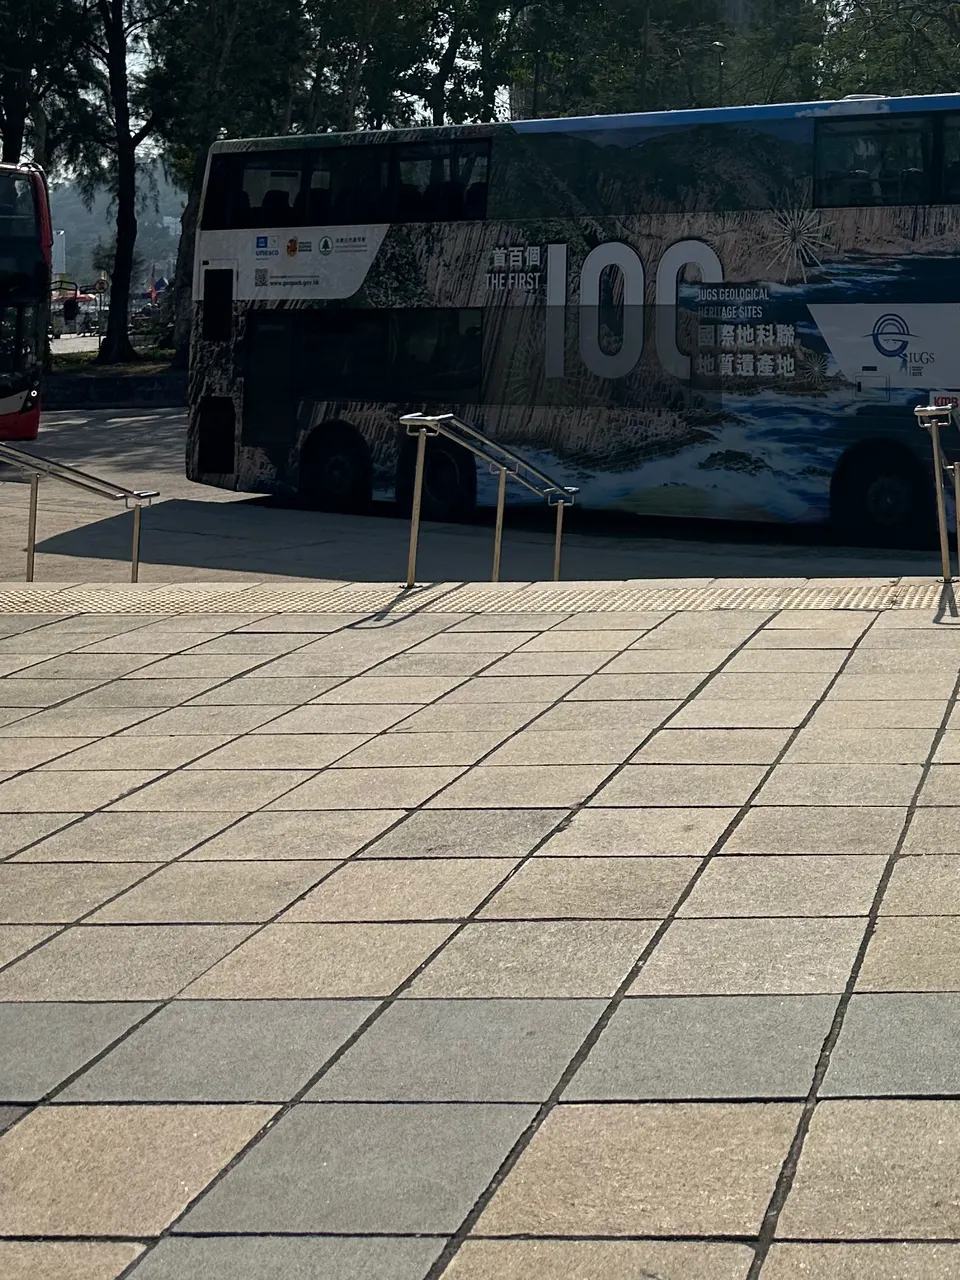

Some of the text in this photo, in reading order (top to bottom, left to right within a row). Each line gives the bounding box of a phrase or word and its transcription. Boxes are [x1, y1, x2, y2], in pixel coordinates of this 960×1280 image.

[492, 245, 541, 268] 首百個
[269, 279, 319, 287] www.geopark.gov.hk
[484, 272, 541, 290] THE FIRST
[697, 288, 770, 300] IUGS GEOLOGICAL
[545, 239, 725, 379] 100
[697, 306, 763, 318] HERITAGE SITES
[697, 323, 795, 348] 國際地科聯
[697, 353, 796, 377] 地質遺產地
[909, 352, 935, 364] IUGS
